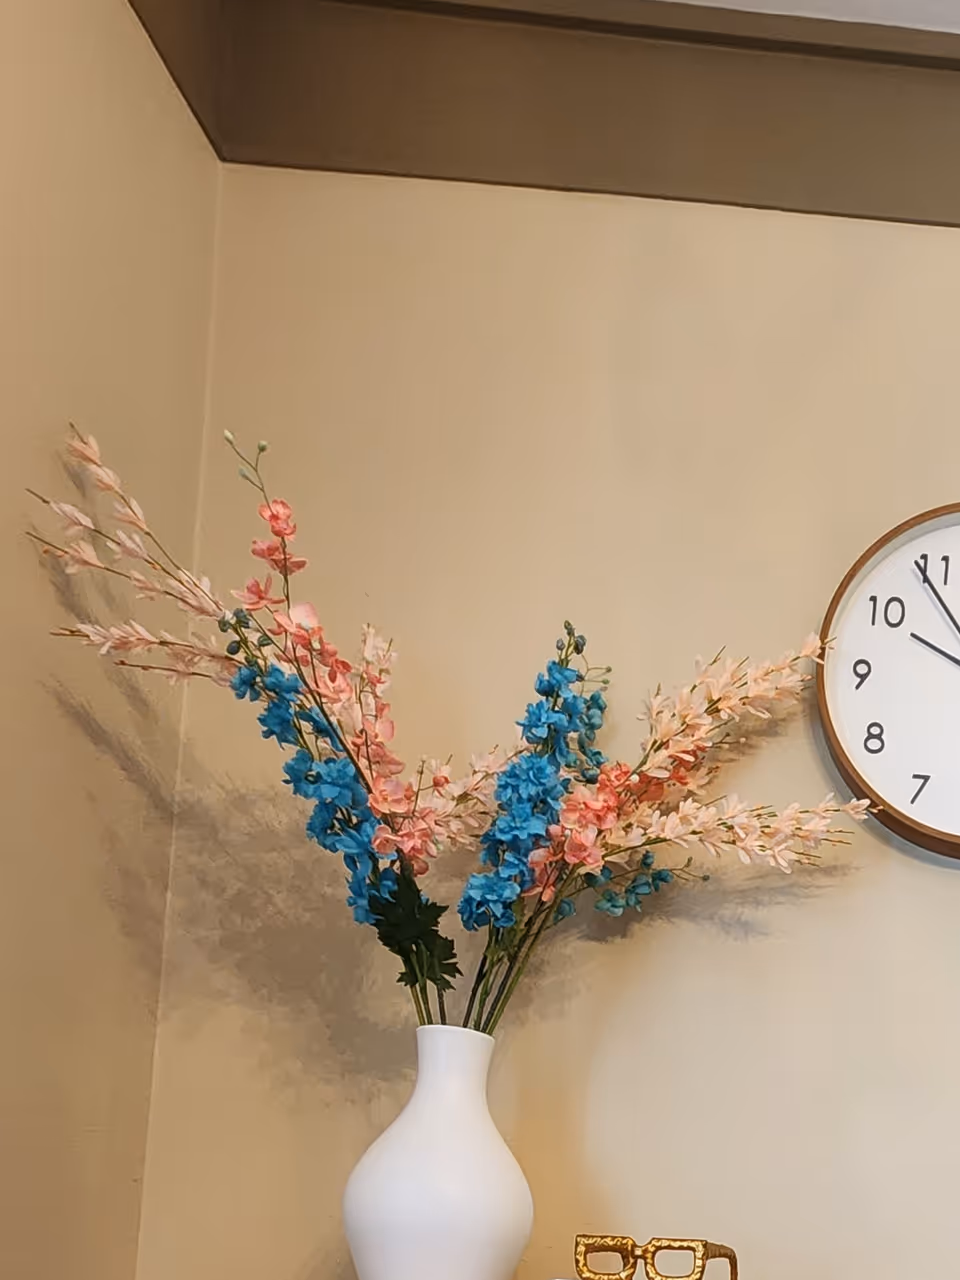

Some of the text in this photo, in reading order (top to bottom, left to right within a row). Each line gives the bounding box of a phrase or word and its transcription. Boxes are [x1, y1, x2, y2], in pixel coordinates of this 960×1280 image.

[919, 553, 951, 586] 11
[868, 595, 906, 628] 10
[852, 658, 872, 690] 9
[863, 722, 886, 754] 8
[910, 773, 931, 805] 7
